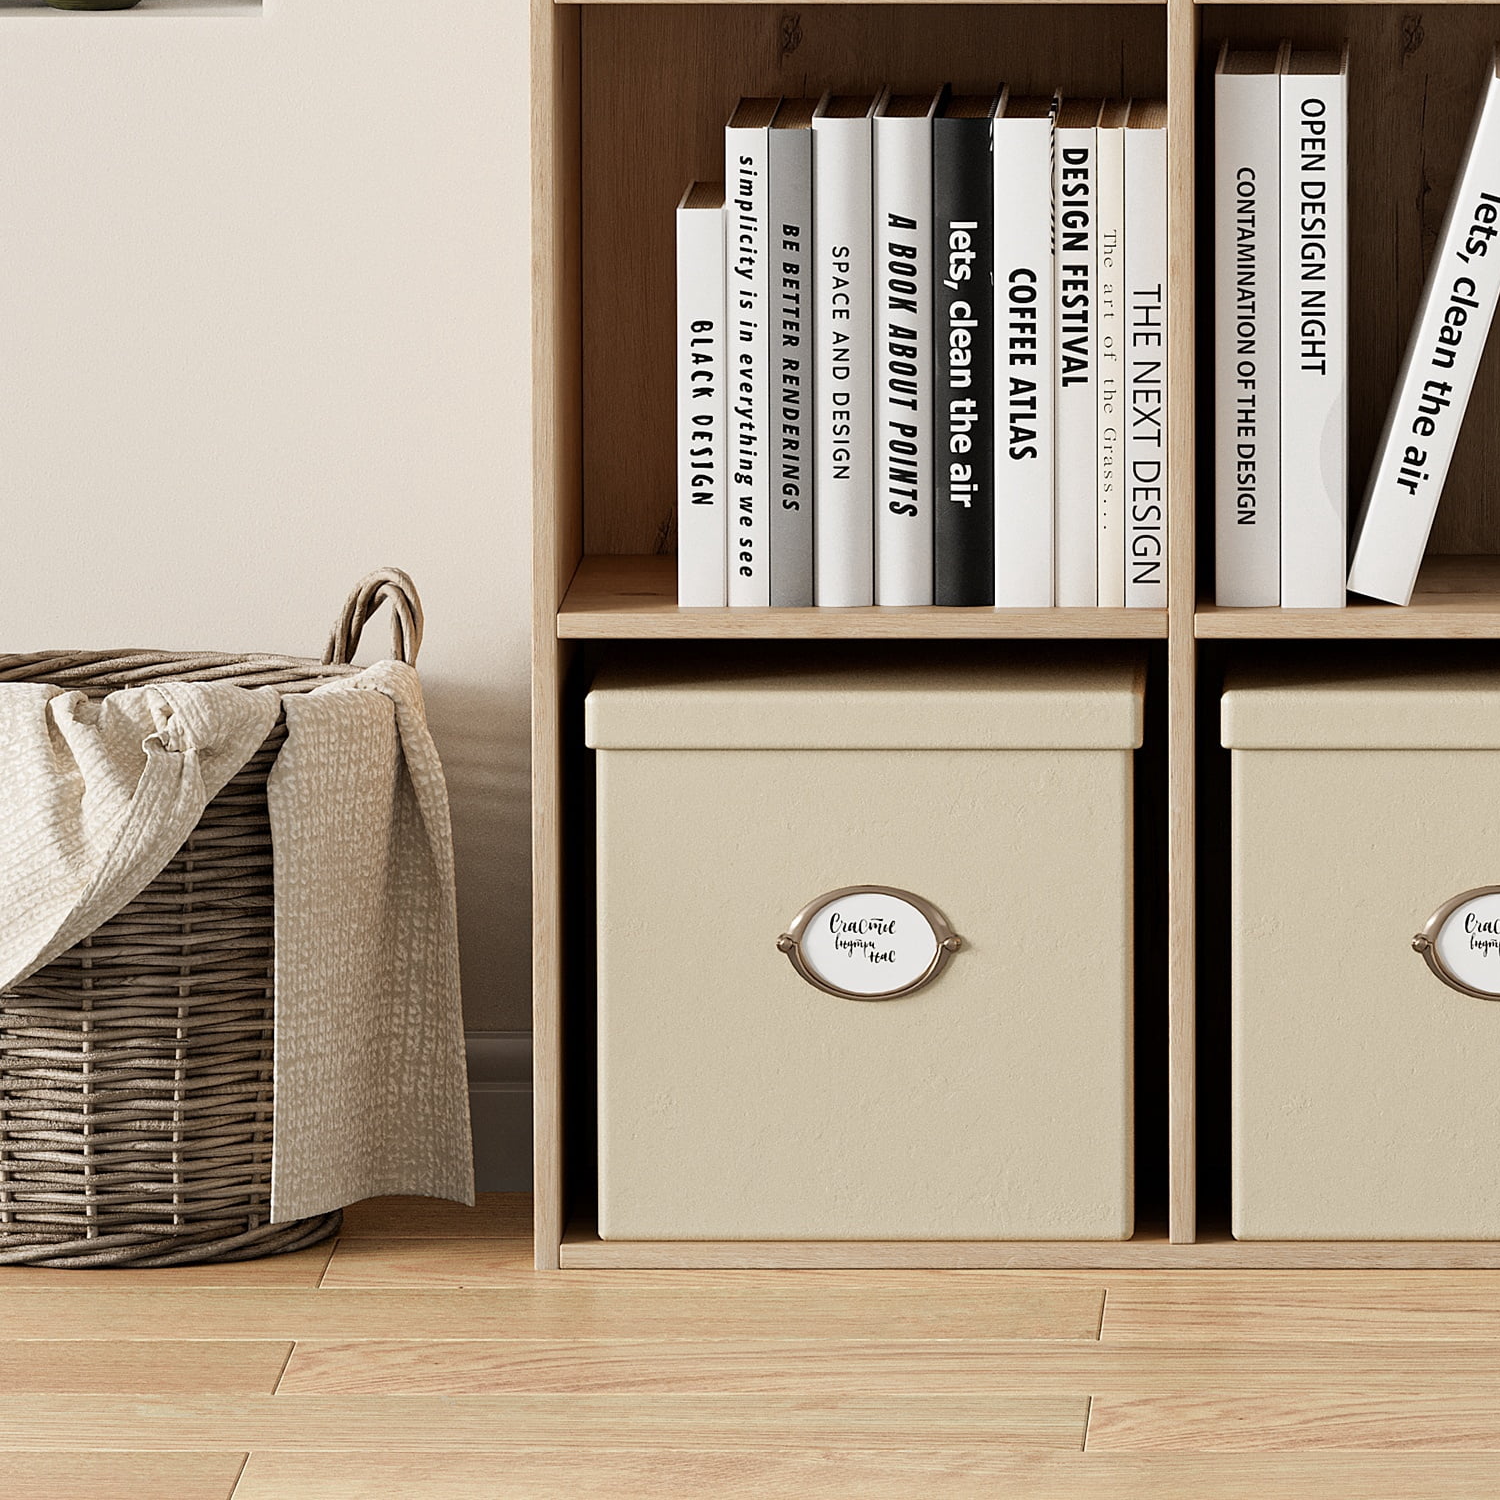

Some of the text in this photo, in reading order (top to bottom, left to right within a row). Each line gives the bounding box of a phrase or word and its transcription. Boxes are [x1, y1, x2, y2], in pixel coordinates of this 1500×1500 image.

[1062, 148, 1089, 387] DESIGN FESTIVAL
[1103, 228, 1117, 268] The
[1103, 283, 1115, 319] art
[1301, 98, 1326, 375] OPEN DESIGN NIGHT
[1432, 276, 1479, 369] clean
[690, 321, 714, 505] BLACK DESIGN
[734, 156, 758, 577] simplicity is in everything we see
[781, 224, 800, 511] BE BETTER RENDERINGS
[832, 245, 850, 480] SPACE AND DESIGN
[887, 212, 918, 517] A BOOK ABOUT POINTS
[944, 222, 978, 507] lets, clean the air
[1009, 268, 1037, 460] COFFEE ATLAS
[1104, 336, 1117, 361] of
[1104, 380, 1117, 413] the
[1132, 284, 1161, 583] THE NEXT DESIGN
[1237, 167, 1256, 524] CONTAMINATION OF THE DESIGN
[1412, 376, 1452, 437] the
[1397, 446, 1429, 497] air
